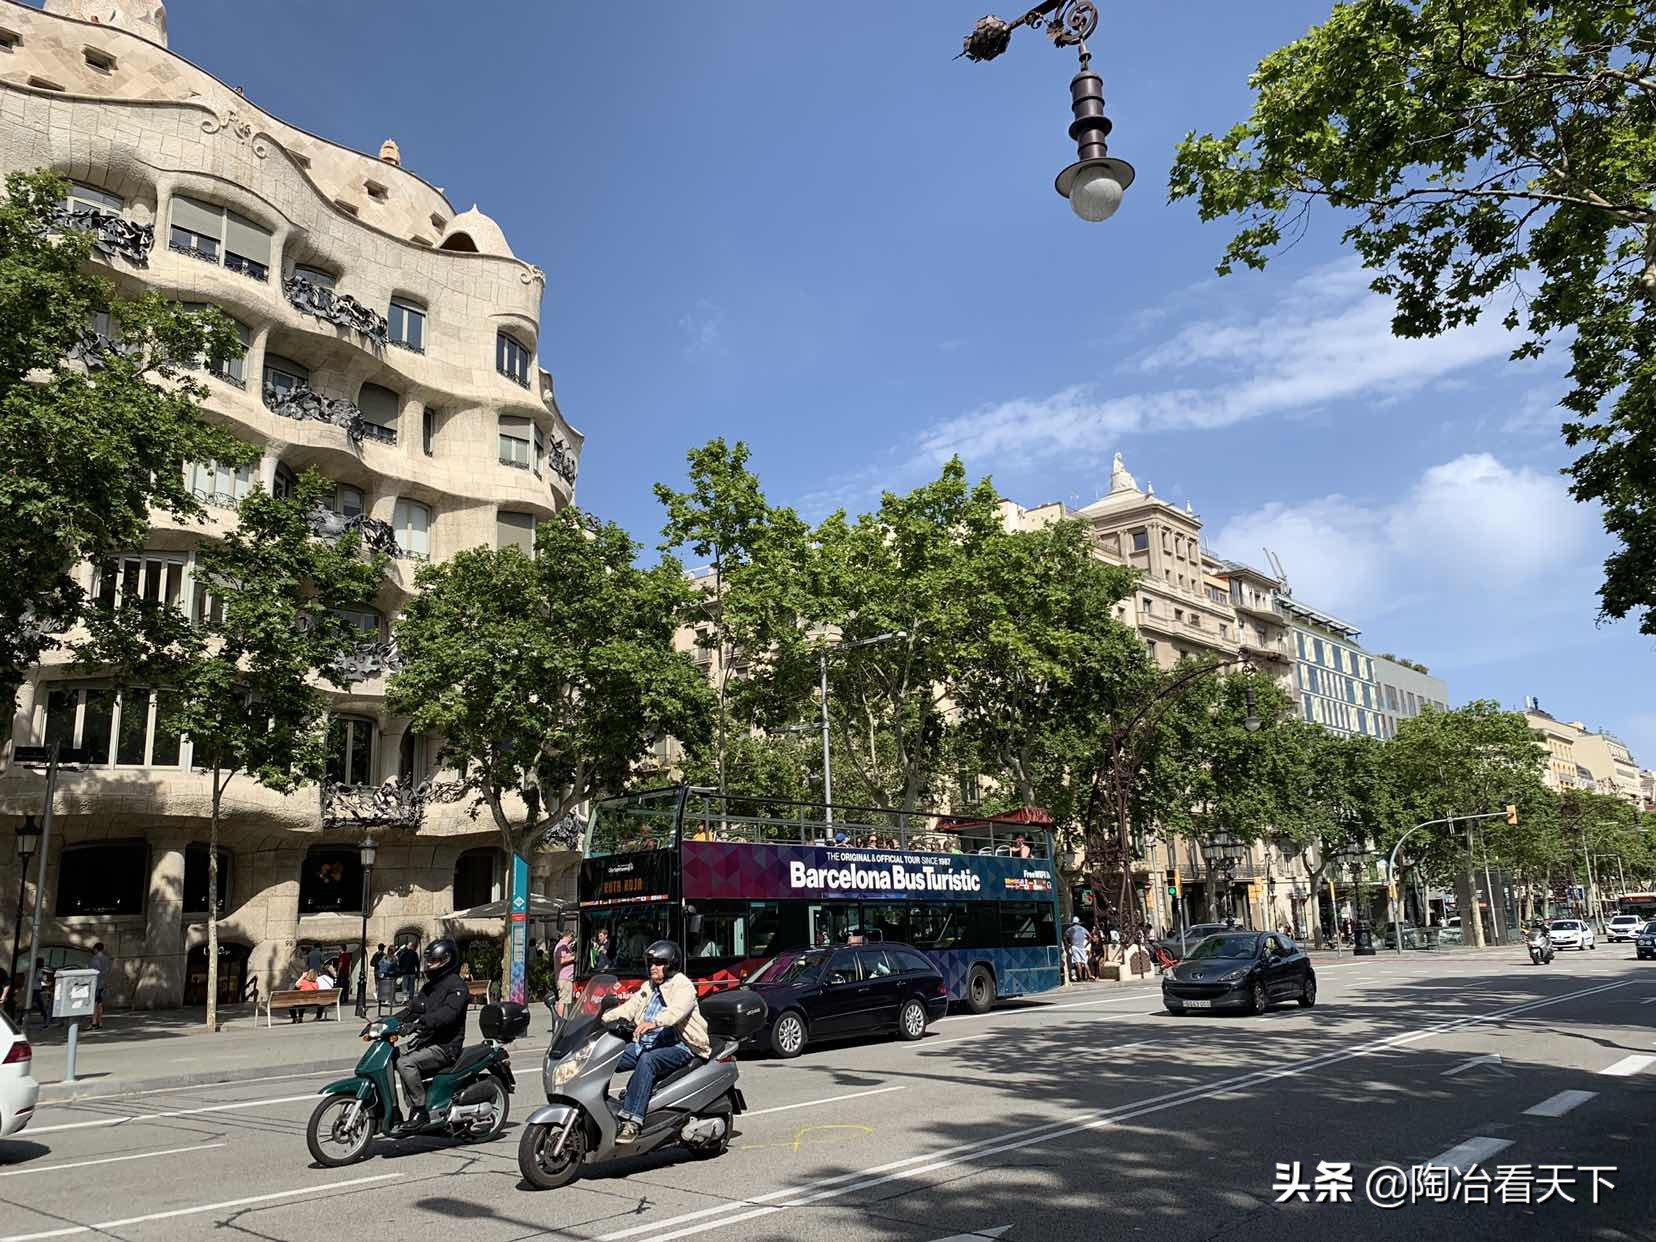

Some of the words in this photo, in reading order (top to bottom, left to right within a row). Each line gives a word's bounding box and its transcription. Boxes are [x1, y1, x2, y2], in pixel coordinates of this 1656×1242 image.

[826, 852, 840, 861] THE
[840, 853, 871, 863] ORIGINAL
[876, 854, 904, 864] OFFICIAL
[904, 855, 920, 865] TOUR
[920, 856, 938, 865] SINCE
[789, 861, 891, 889] Barcelona
[892, 865, 981, 892] BusTurístic
